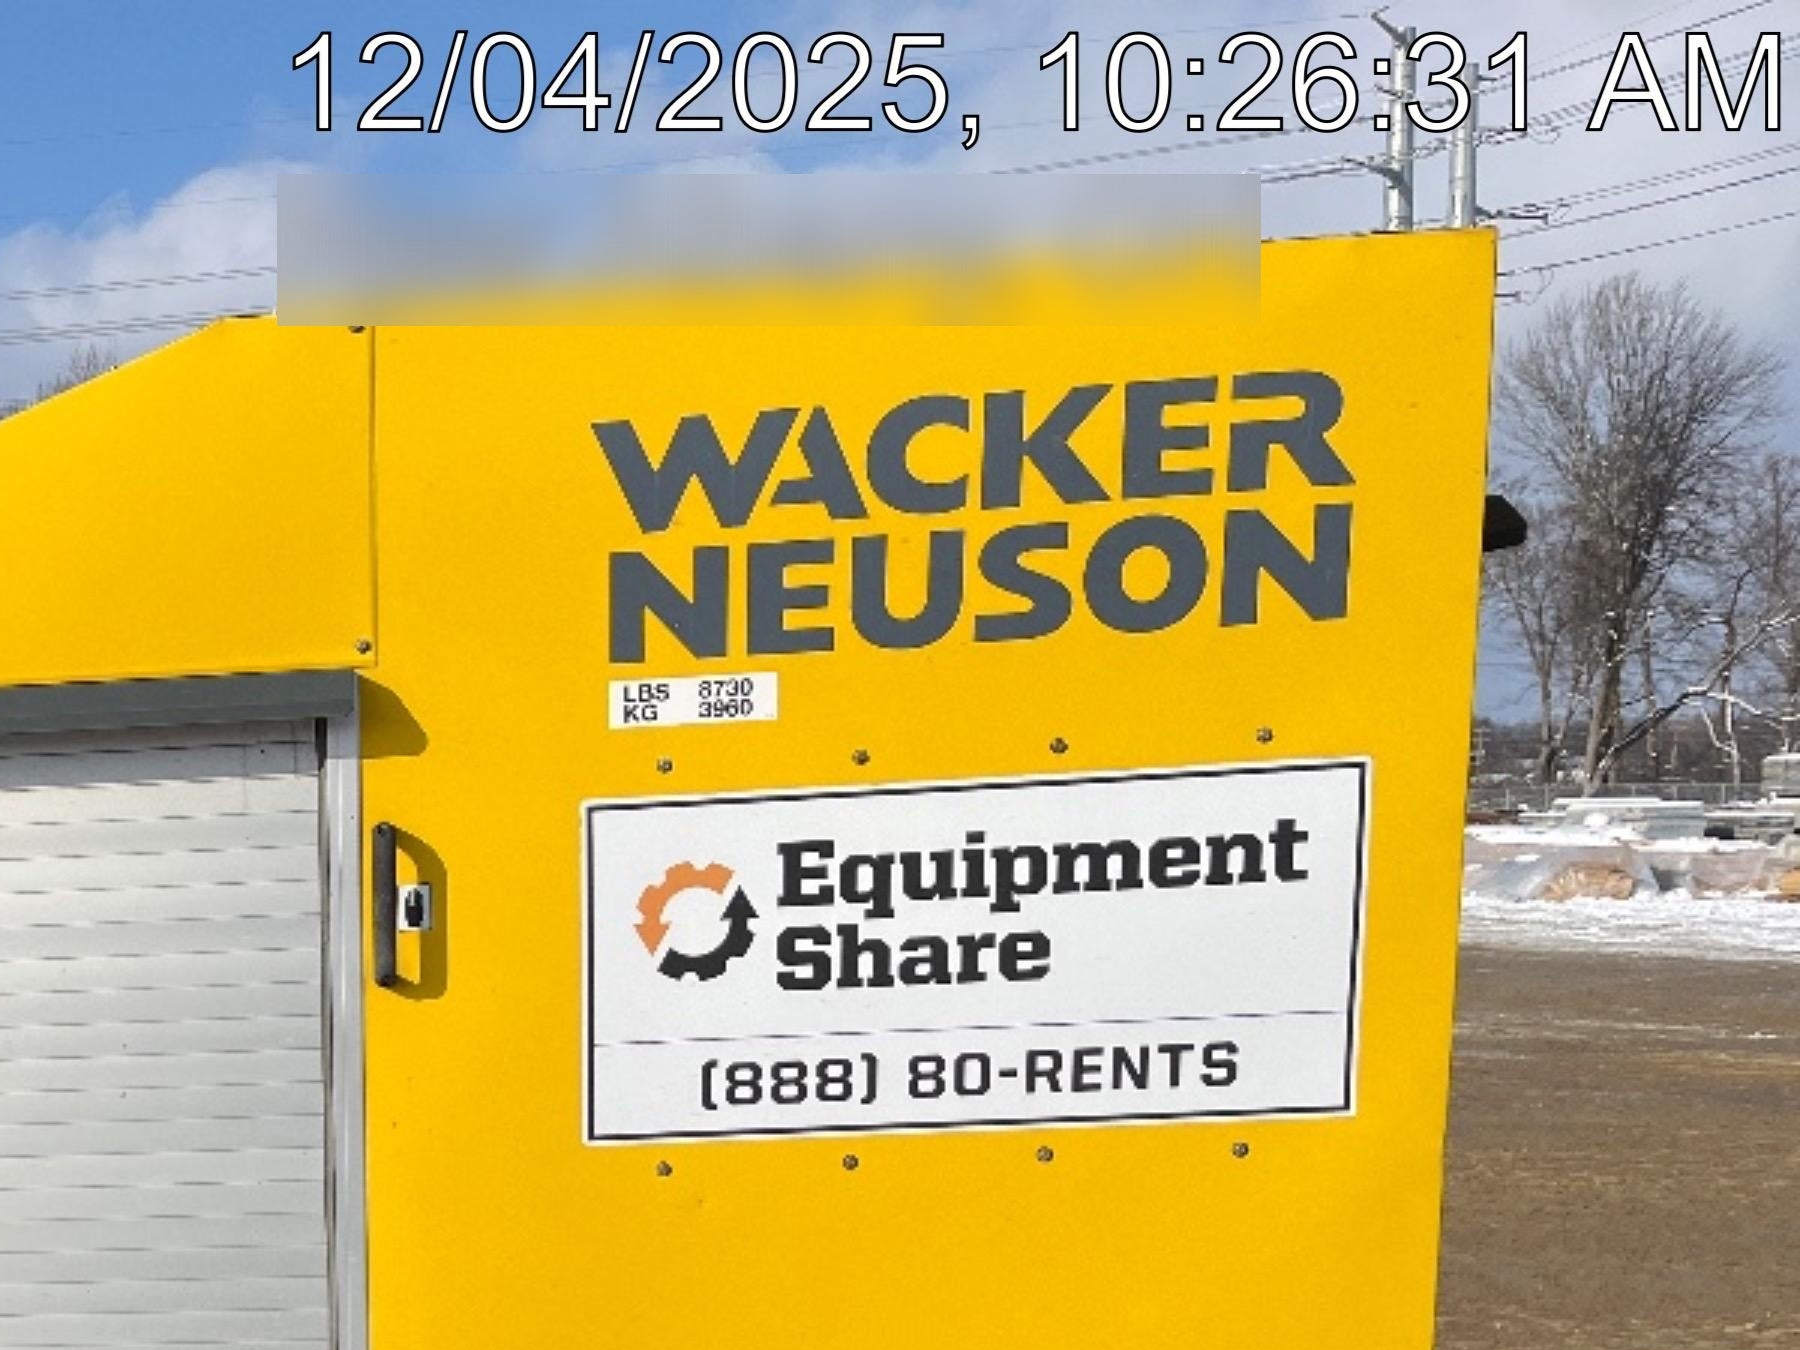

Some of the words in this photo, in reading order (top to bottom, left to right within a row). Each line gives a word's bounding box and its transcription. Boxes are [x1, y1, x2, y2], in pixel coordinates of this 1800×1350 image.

[591, 370, 1356, 535] WACKER
[609, 503, 1354, 664] NEUSON
[623, 683, 670, 703] LBS
[698, 677, 754, 699] 8730
[623, 704, 658, 724] KG
[698, 698, 754, 718] 3960
[777, 818, 1309, 919] Equipment
[776, 923, 1052, 991] Share
[701, 1053, 878, 1111] (888)
[908, 1041, 1239, 1099] 80-RENTS
